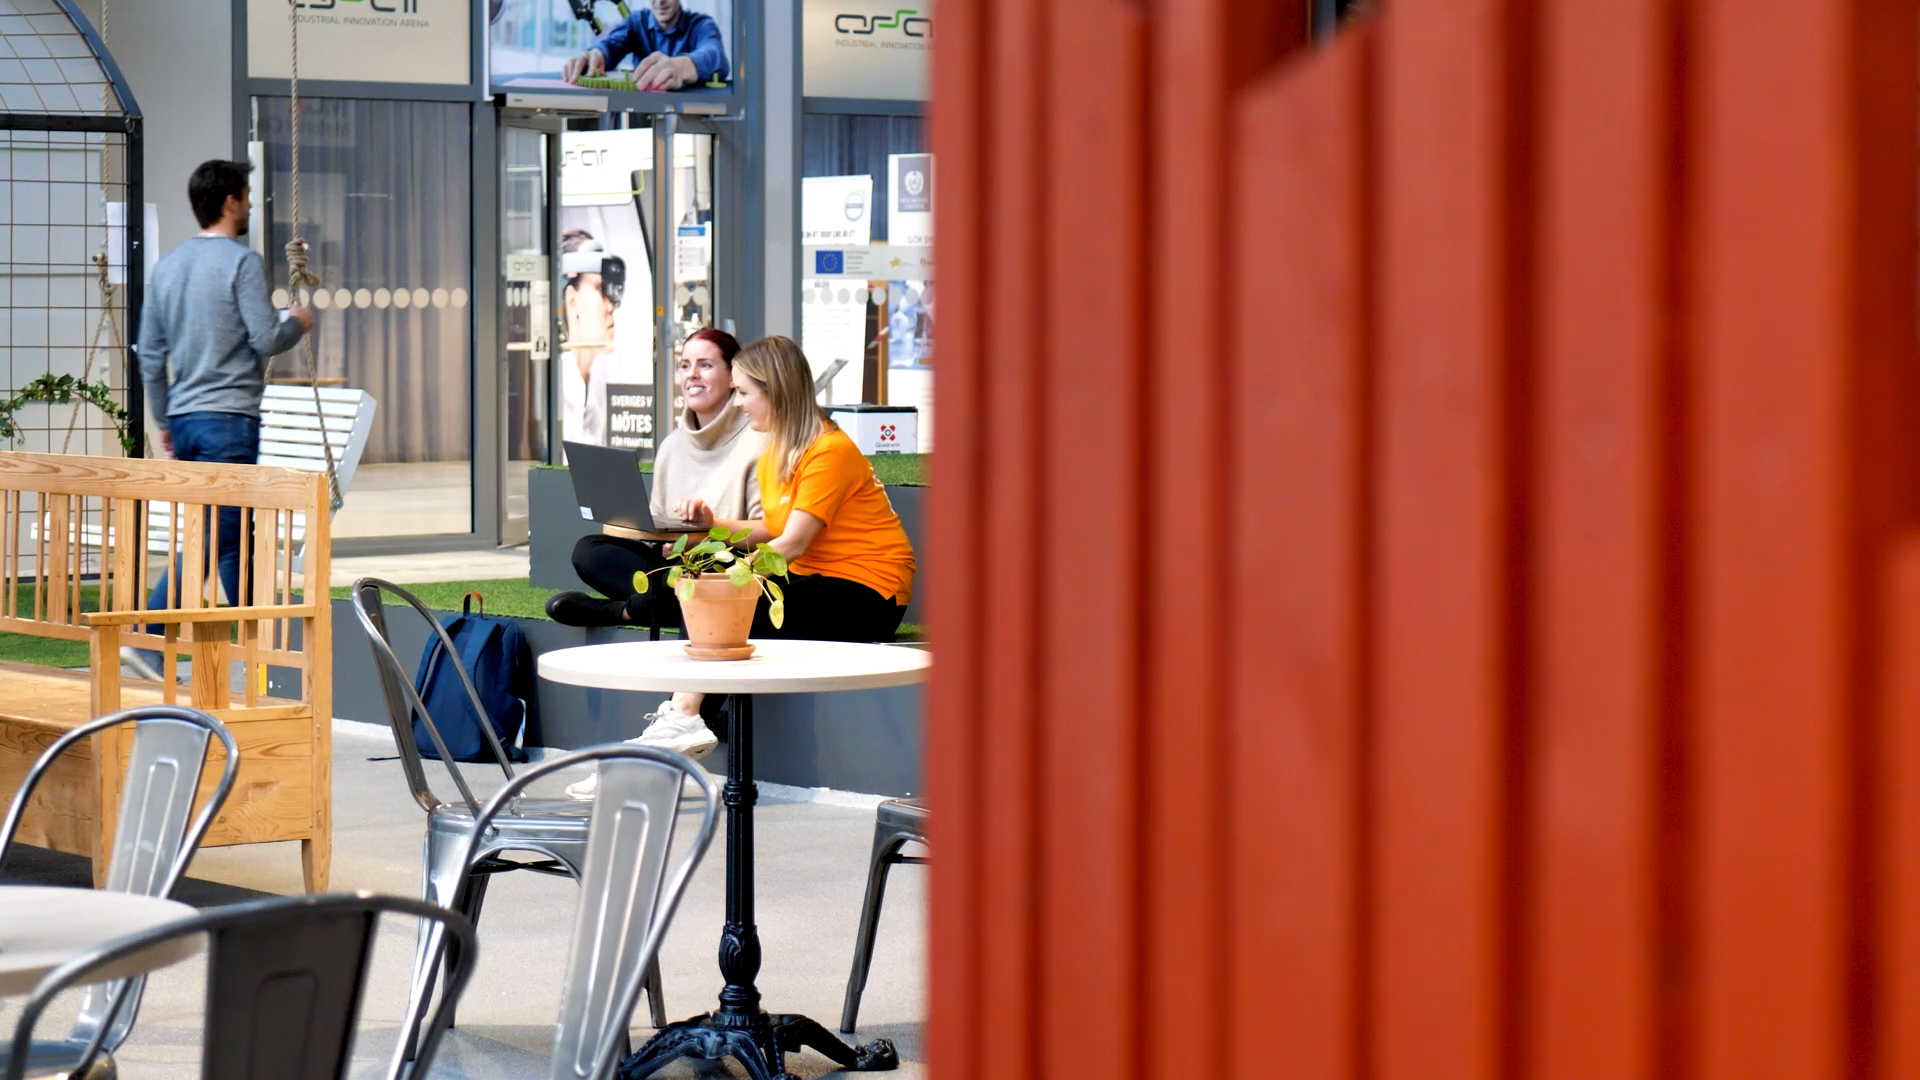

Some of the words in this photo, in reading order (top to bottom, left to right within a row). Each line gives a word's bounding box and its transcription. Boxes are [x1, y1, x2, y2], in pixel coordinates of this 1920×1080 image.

[343, 17, 398, 27] INNOVATION
[400, 19, 430, 28] ARENA
[835, 39, 878, 49] INDUSTRIAL
[611, 395, 645, 408] SVERIGES
[611, 410, 653, 434] MÖTES
[623, 436, 654, 449] FRAMTIDE
